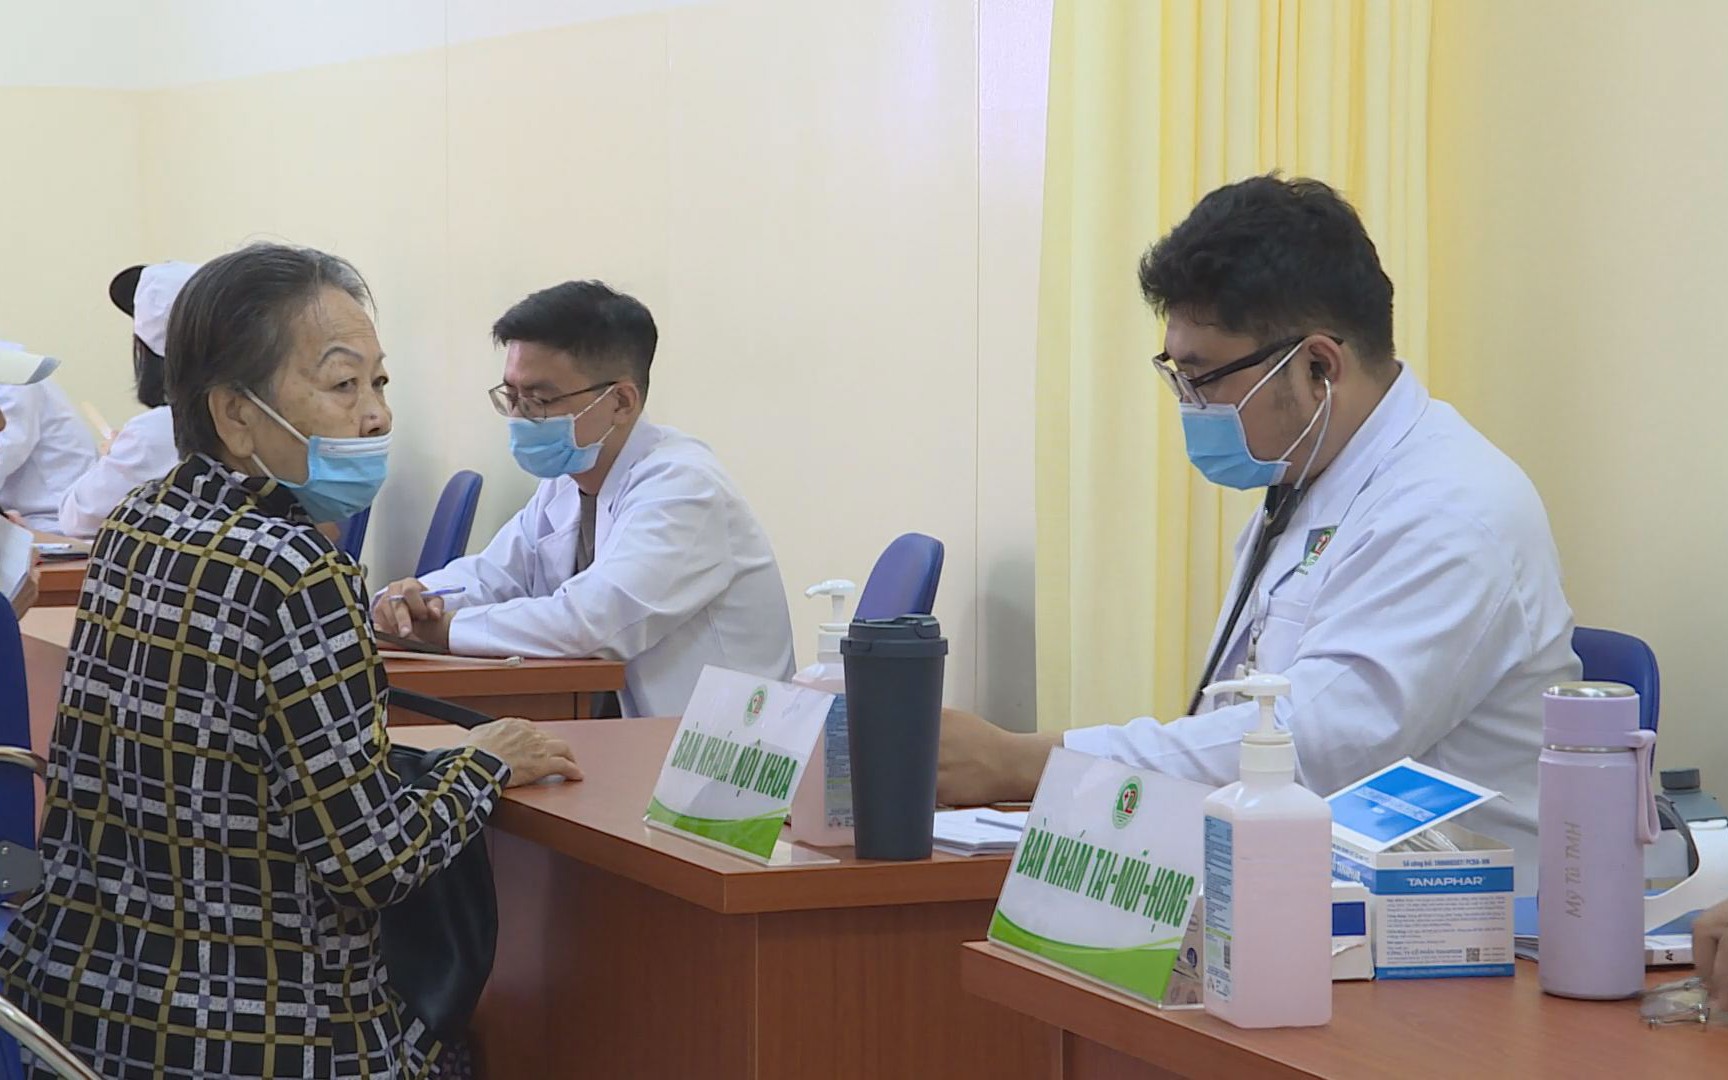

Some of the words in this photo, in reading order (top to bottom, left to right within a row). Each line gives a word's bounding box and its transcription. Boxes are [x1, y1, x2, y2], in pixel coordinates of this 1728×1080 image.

[671, 721, 704, 771] BÀN
[695, 730, 739, 783] KHÁM
[730, 738, 763, 798] NỘI
[753, 751, 798, 801] KHOA
[1016, 817, 1054, 880] BÀN
[1044, 829, 1094, 894] KHÁM
[1407, 876, 1483, 887] TANAPHAR
